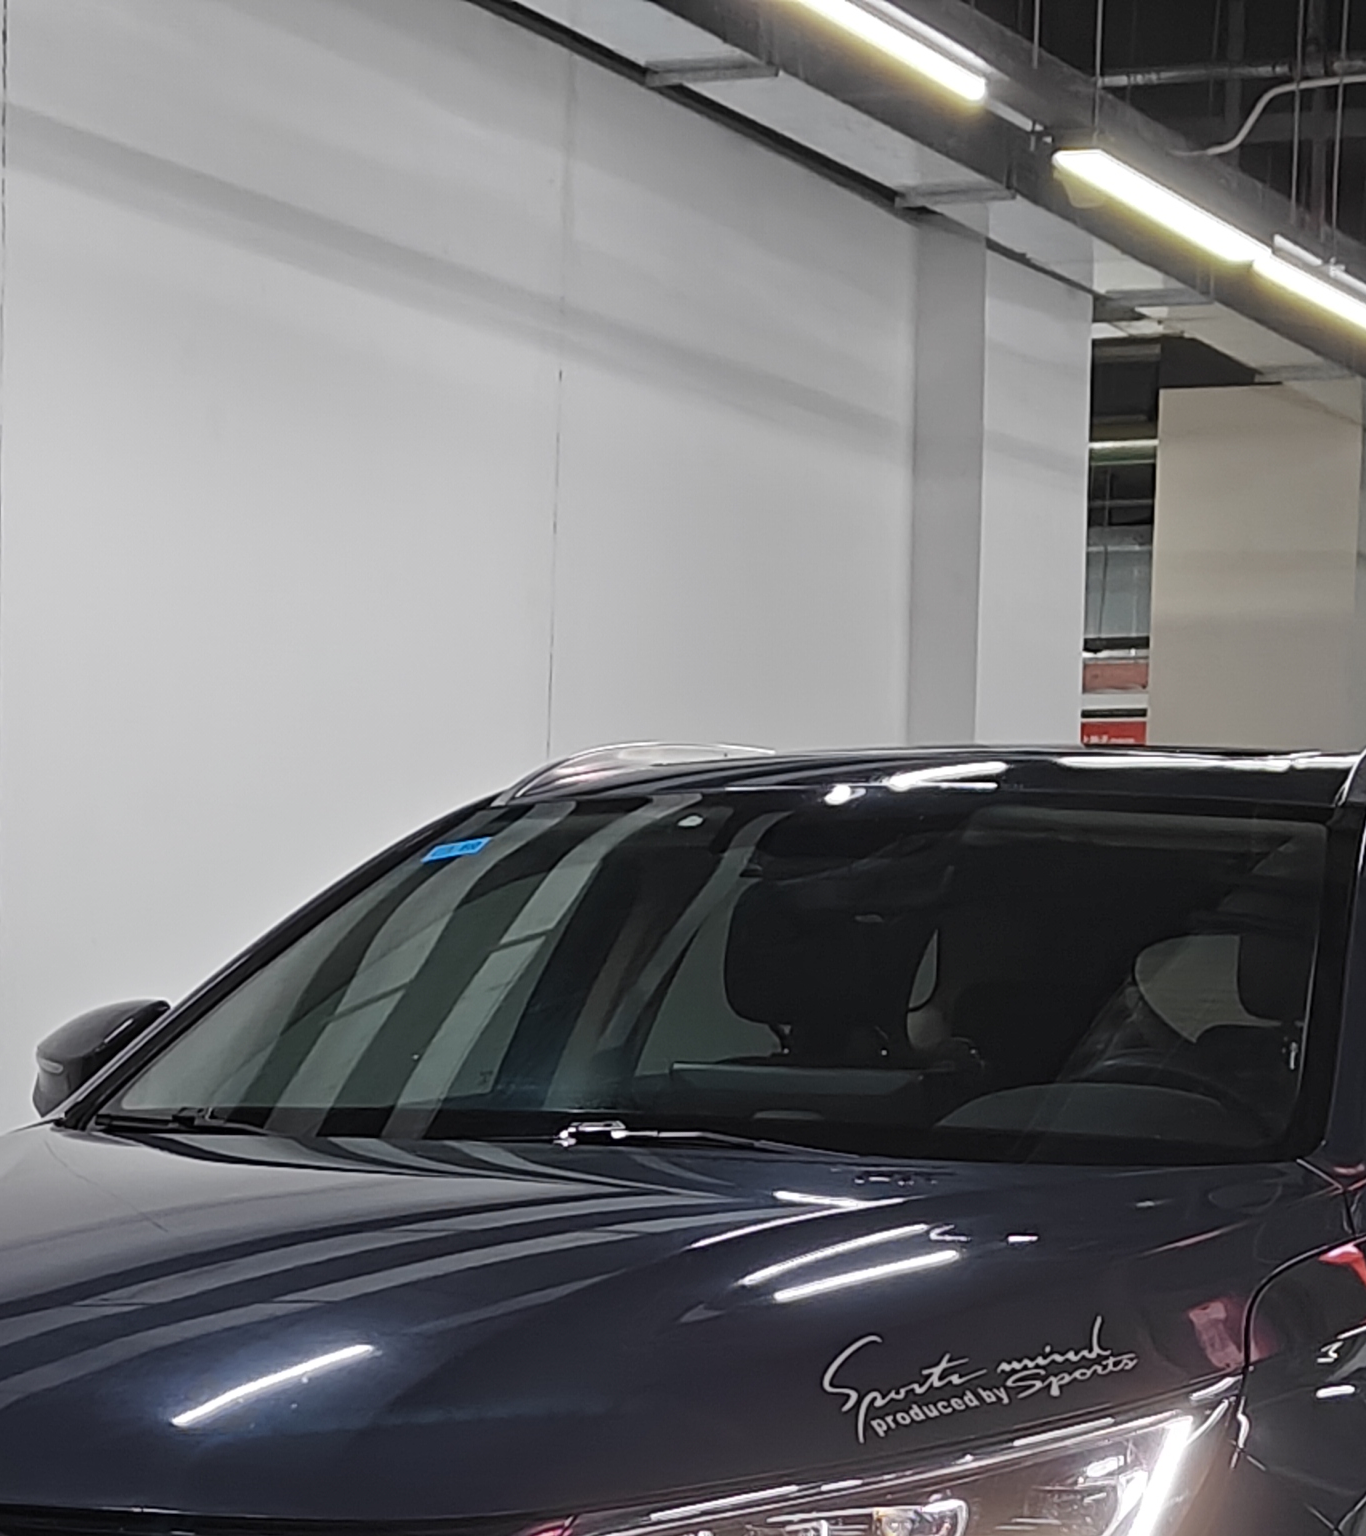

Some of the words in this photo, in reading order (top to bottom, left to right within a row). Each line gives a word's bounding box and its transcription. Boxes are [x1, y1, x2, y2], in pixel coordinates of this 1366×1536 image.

[870, 1390, 981, 1437] produced
[977, 1386, 1010, 1405] by
[1005, 1353, 1138, 1398] Sports
